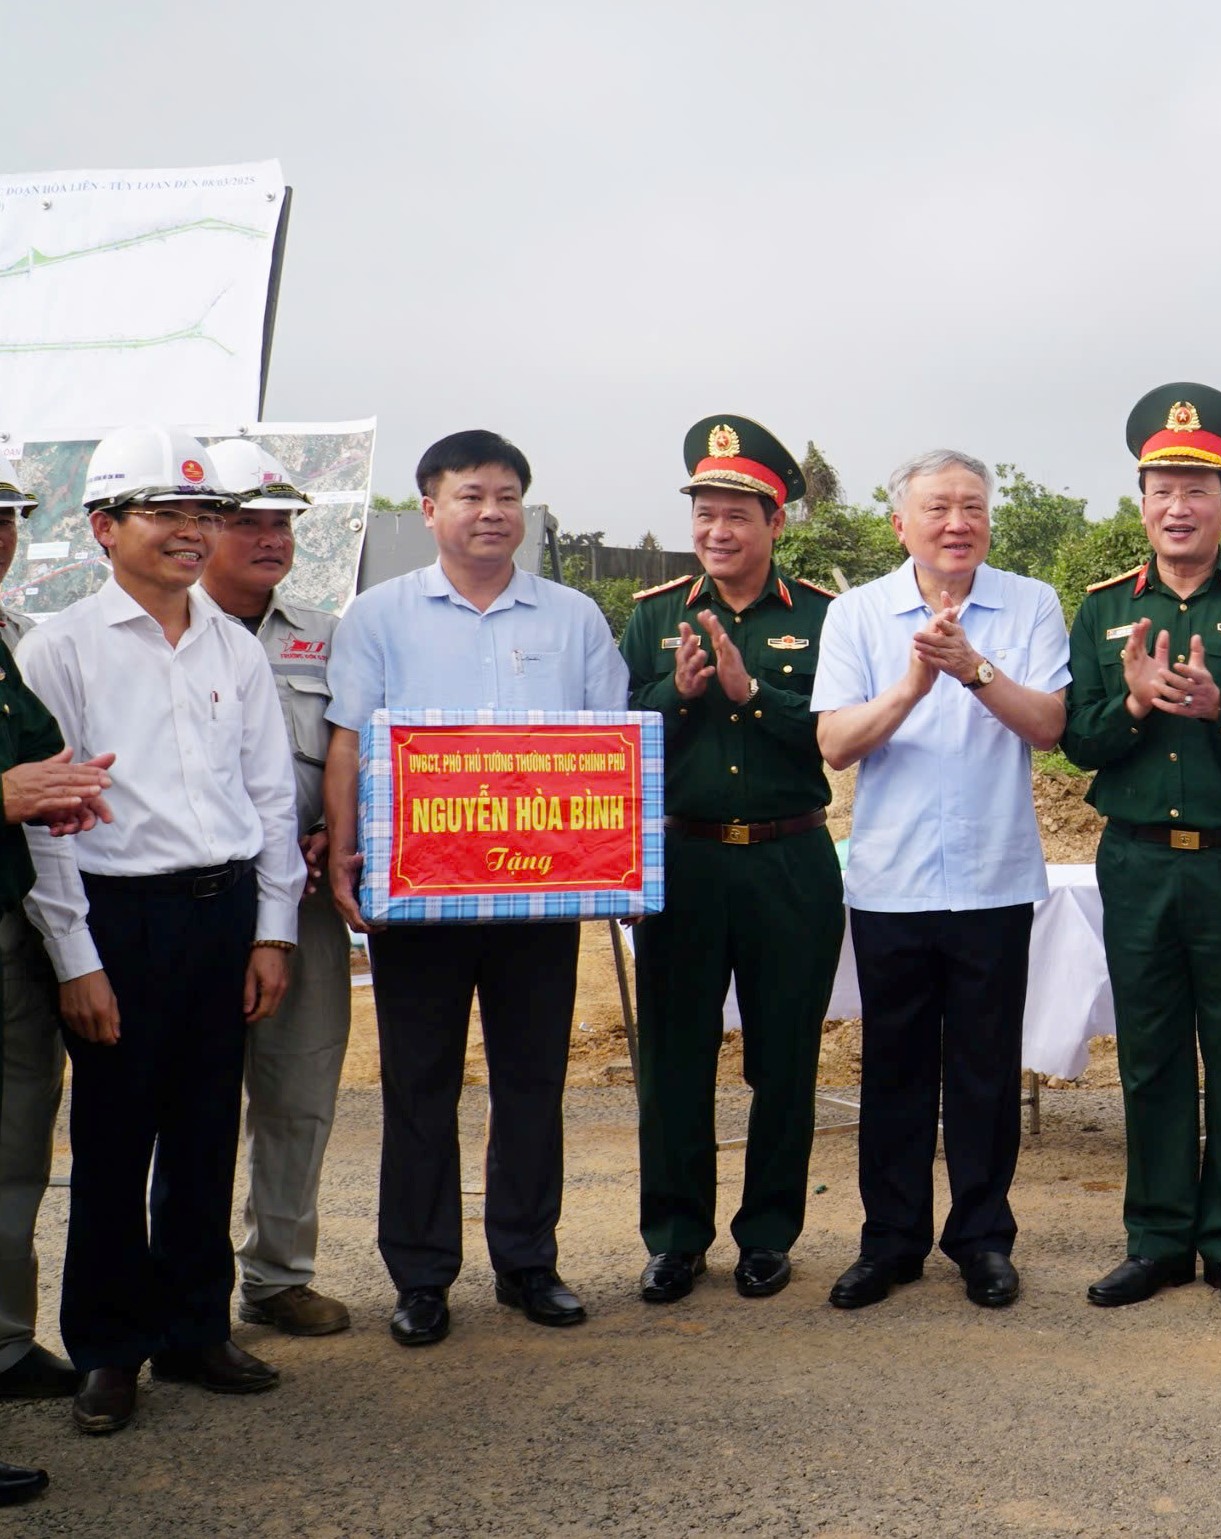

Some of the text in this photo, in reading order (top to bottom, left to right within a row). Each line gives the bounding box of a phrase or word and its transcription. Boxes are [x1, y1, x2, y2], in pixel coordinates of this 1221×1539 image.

[409, 746, 625, 776] UVBCT, PHÓ THỦ TƯỚNG THƯỜNG TRỰC CHÍNH PHỦ
[412, 784, 624, 833] NGUYỄN HÒA BÌNH
[485, 847, 552, 875] Tặng
